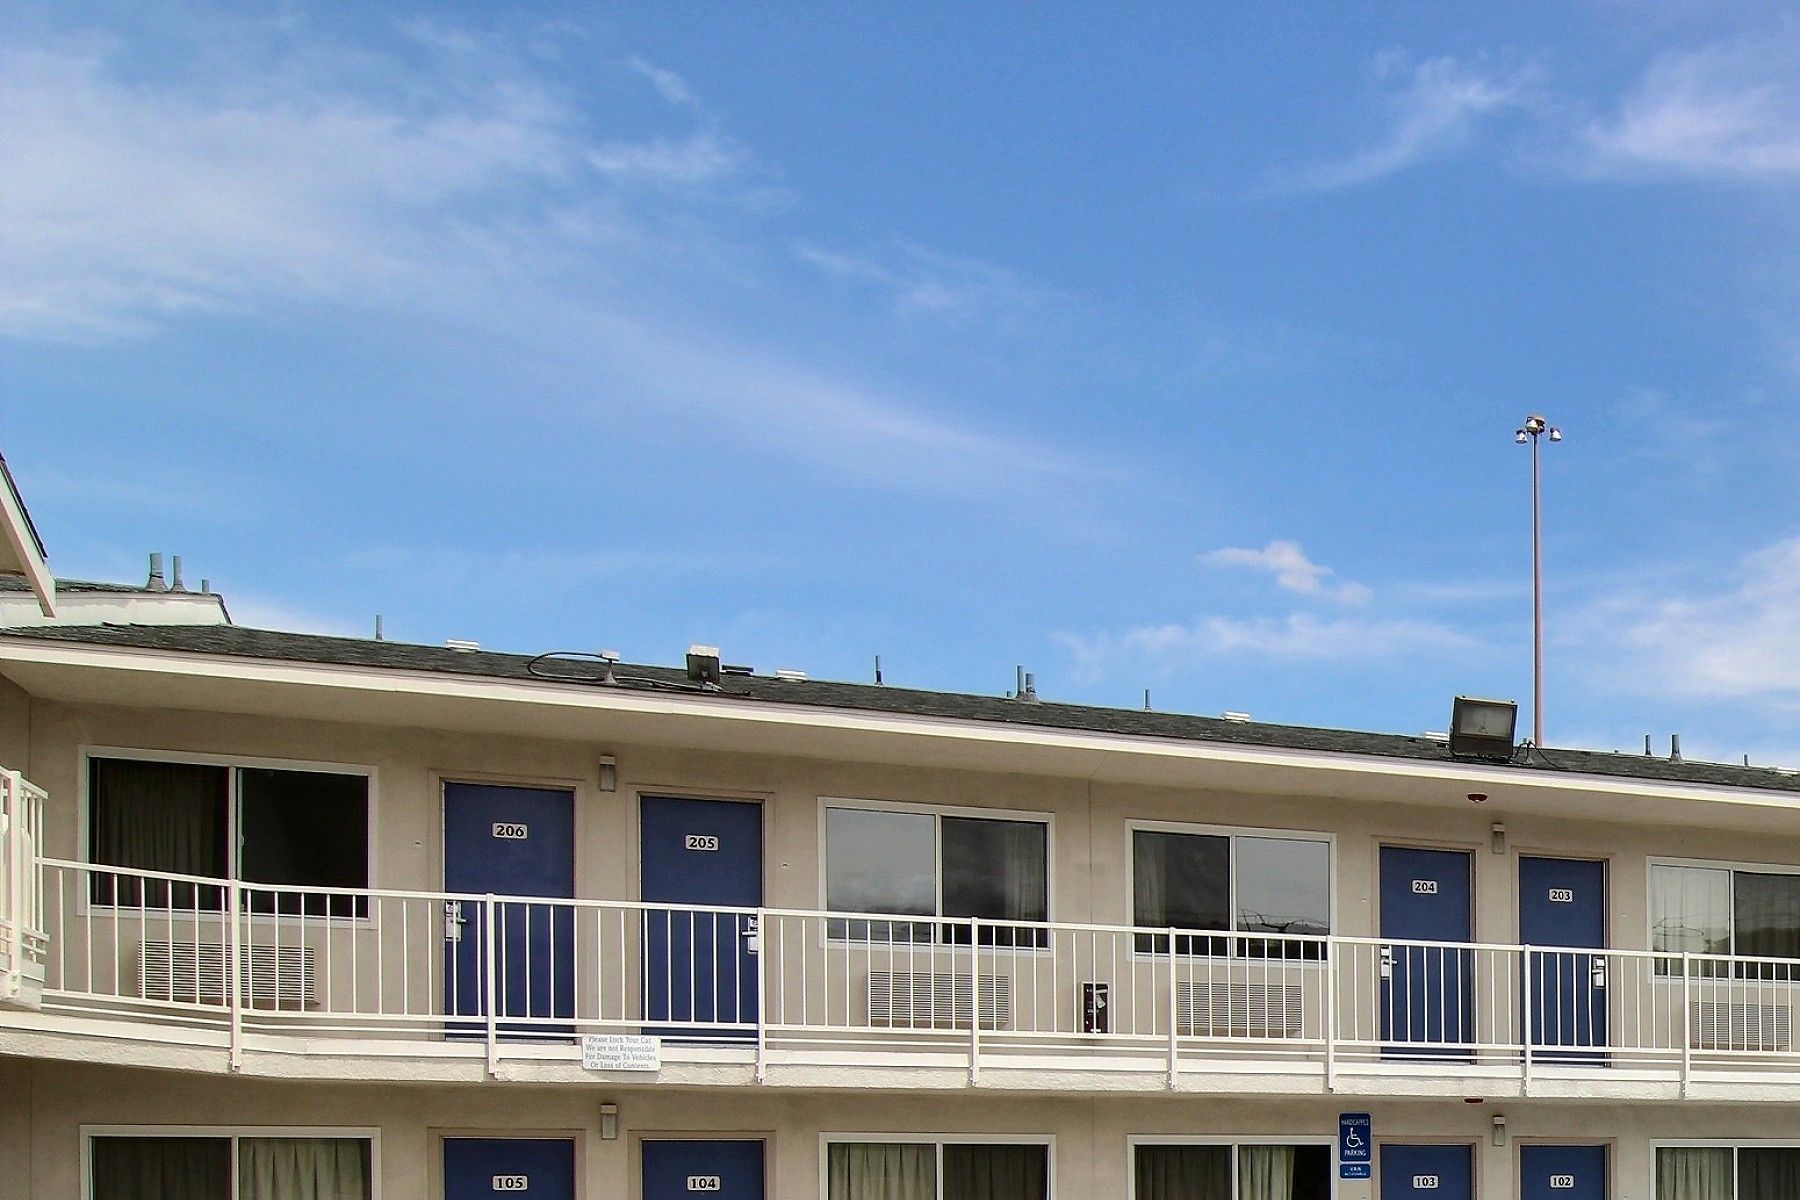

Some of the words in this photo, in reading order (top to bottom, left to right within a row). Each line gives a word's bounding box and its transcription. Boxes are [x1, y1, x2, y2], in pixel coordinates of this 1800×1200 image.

[496, 825, 525, 837] 206
[689, 837, 715, 849] 205
[1415, 882, 1435, 892] 204
[1551, 890, 1571, 901] 203
[1344, 1149, 1367, 1157] PARKING
[497, 1177, 523, 1189] 105
[691, 1178, 716, 1188] 104
[1416, 1177, 1435, 1187] 103
[1553, 1177, 1571, 1187] 102
